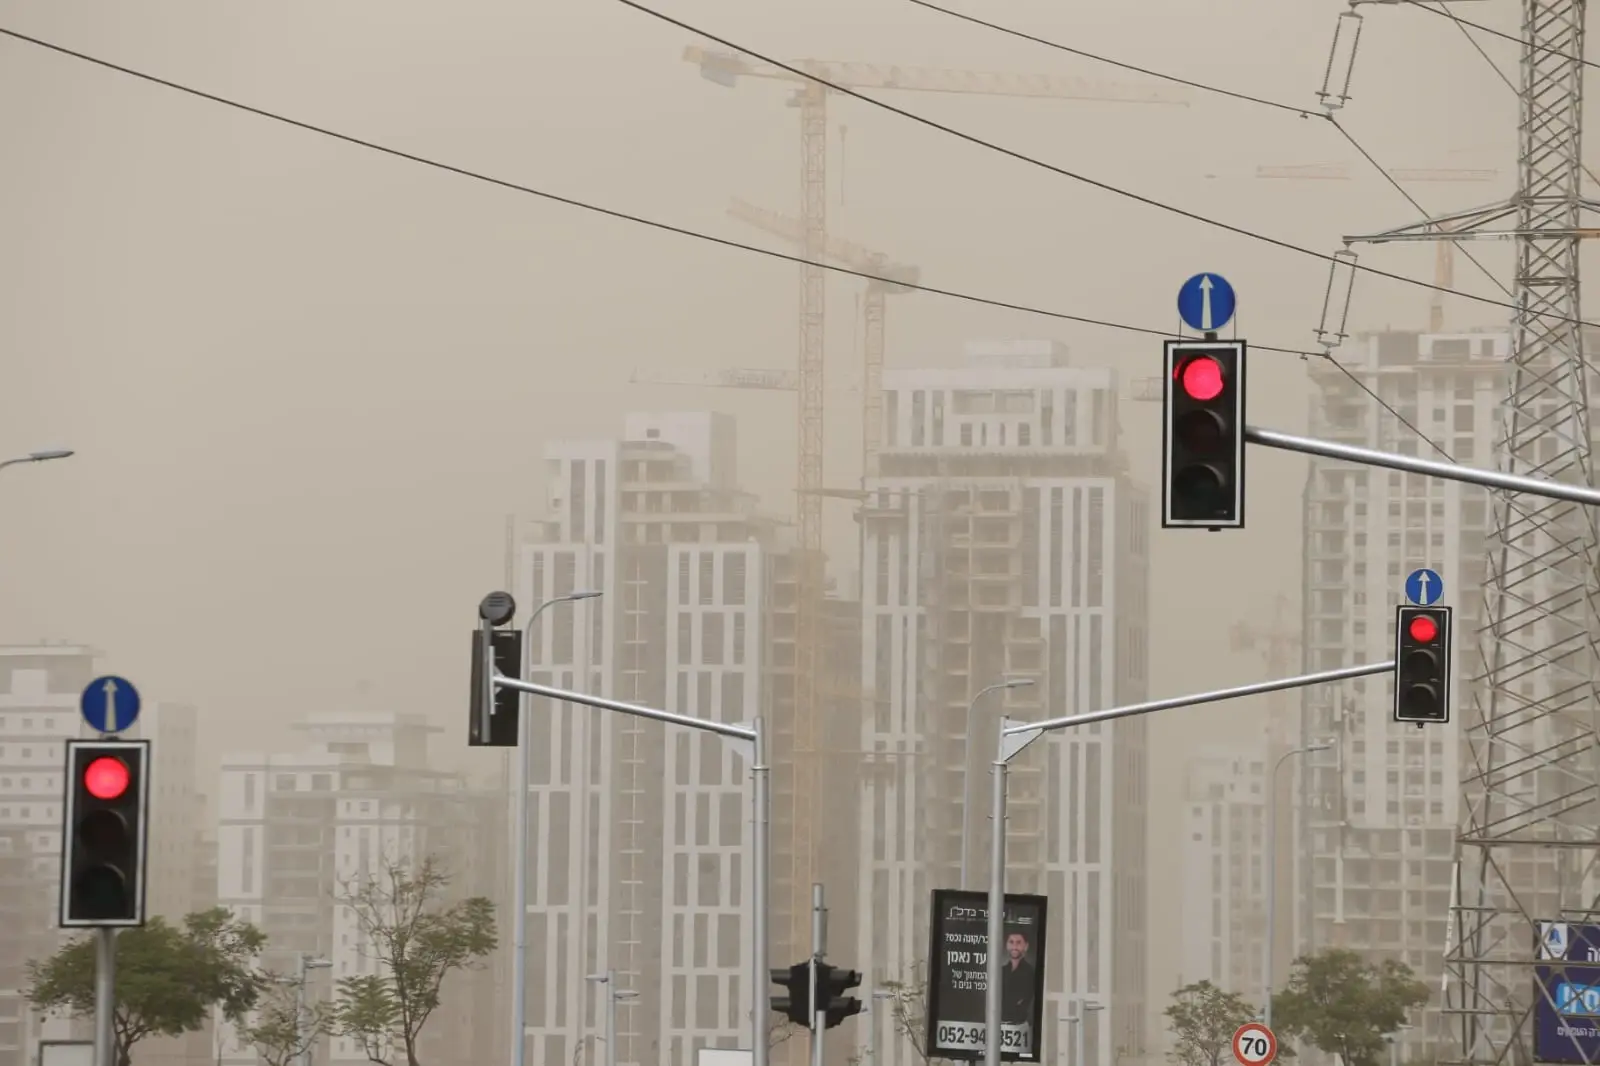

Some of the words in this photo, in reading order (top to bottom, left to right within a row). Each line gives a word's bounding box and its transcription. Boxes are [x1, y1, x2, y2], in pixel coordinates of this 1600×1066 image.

[947, 950, 971, 966] נאמן
[939, 1026, 1029, 1048] 052-94521
[1242, 1037, 1267, 1056] 70
